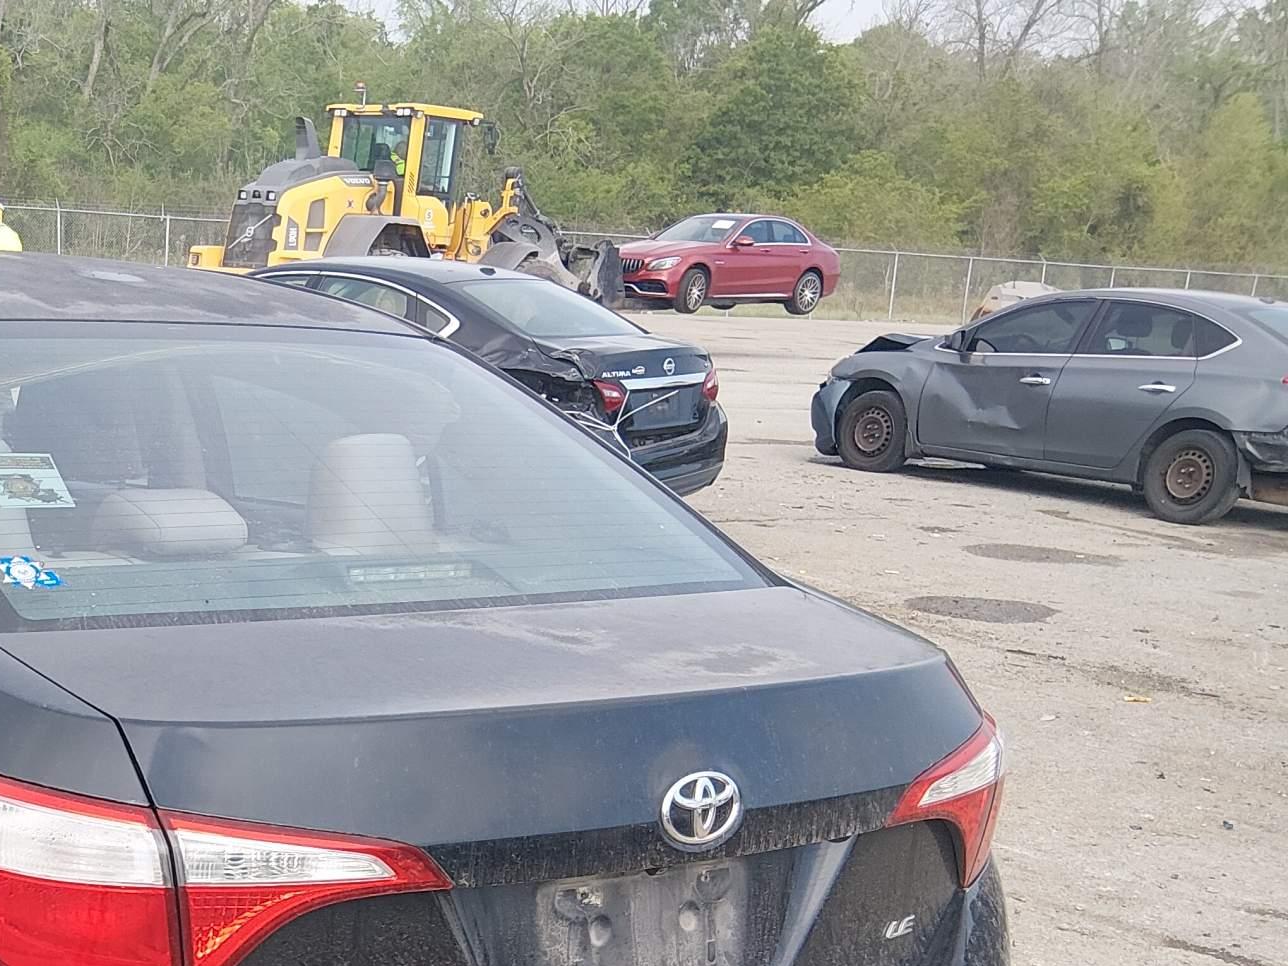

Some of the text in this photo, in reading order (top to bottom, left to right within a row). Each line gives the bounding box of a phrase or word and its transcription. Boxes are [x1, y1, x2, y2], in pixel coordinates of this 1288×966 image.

[342, 177, 371, 185] VOLVO
[601, 370, 632, 379] ALTIMA
[883, 914, 916, 939] LE
